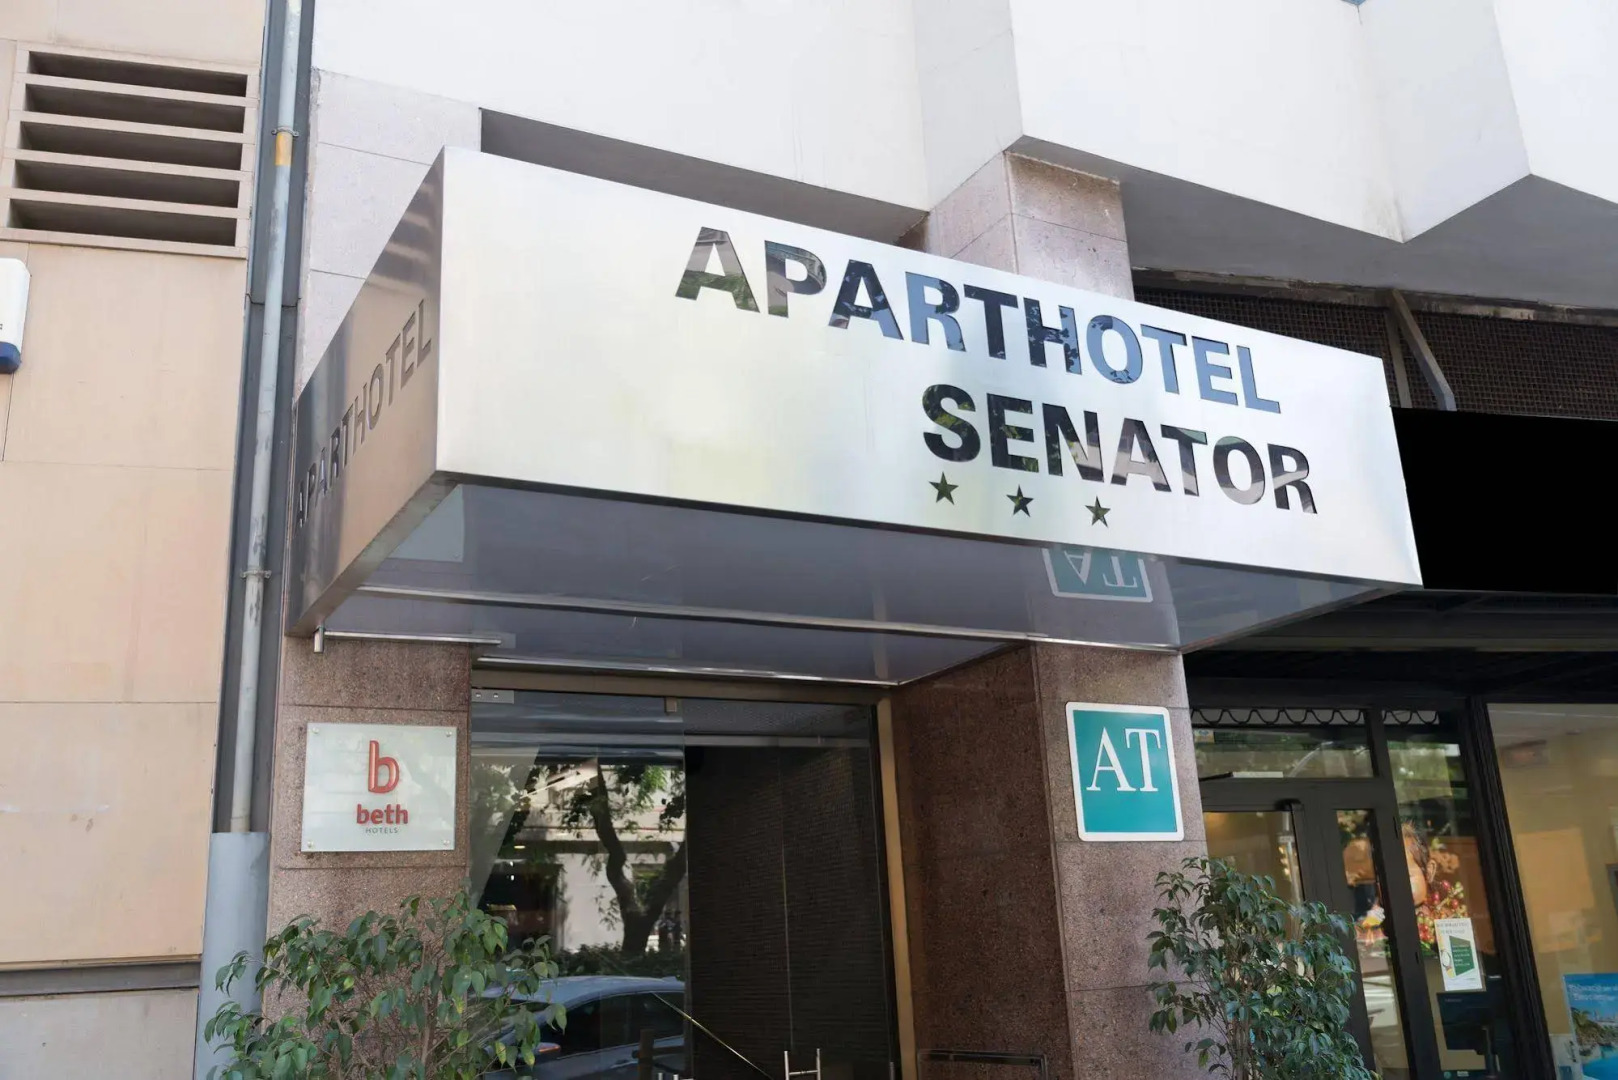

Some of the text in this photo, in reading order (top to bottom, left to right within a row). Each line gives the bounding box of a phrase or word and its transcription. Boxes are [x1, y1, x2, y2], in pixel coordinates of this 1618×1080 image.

[676, 227, 1281, 413] APARTHOTEL
[296, 298, 432, 528] APARTHOTEL
[922, 384, 1317, 514] SENATOR
[367, 740, 400, 794] b
[1086, 726, 1162, 792] AT
[356, 804, 409, 825] beth
